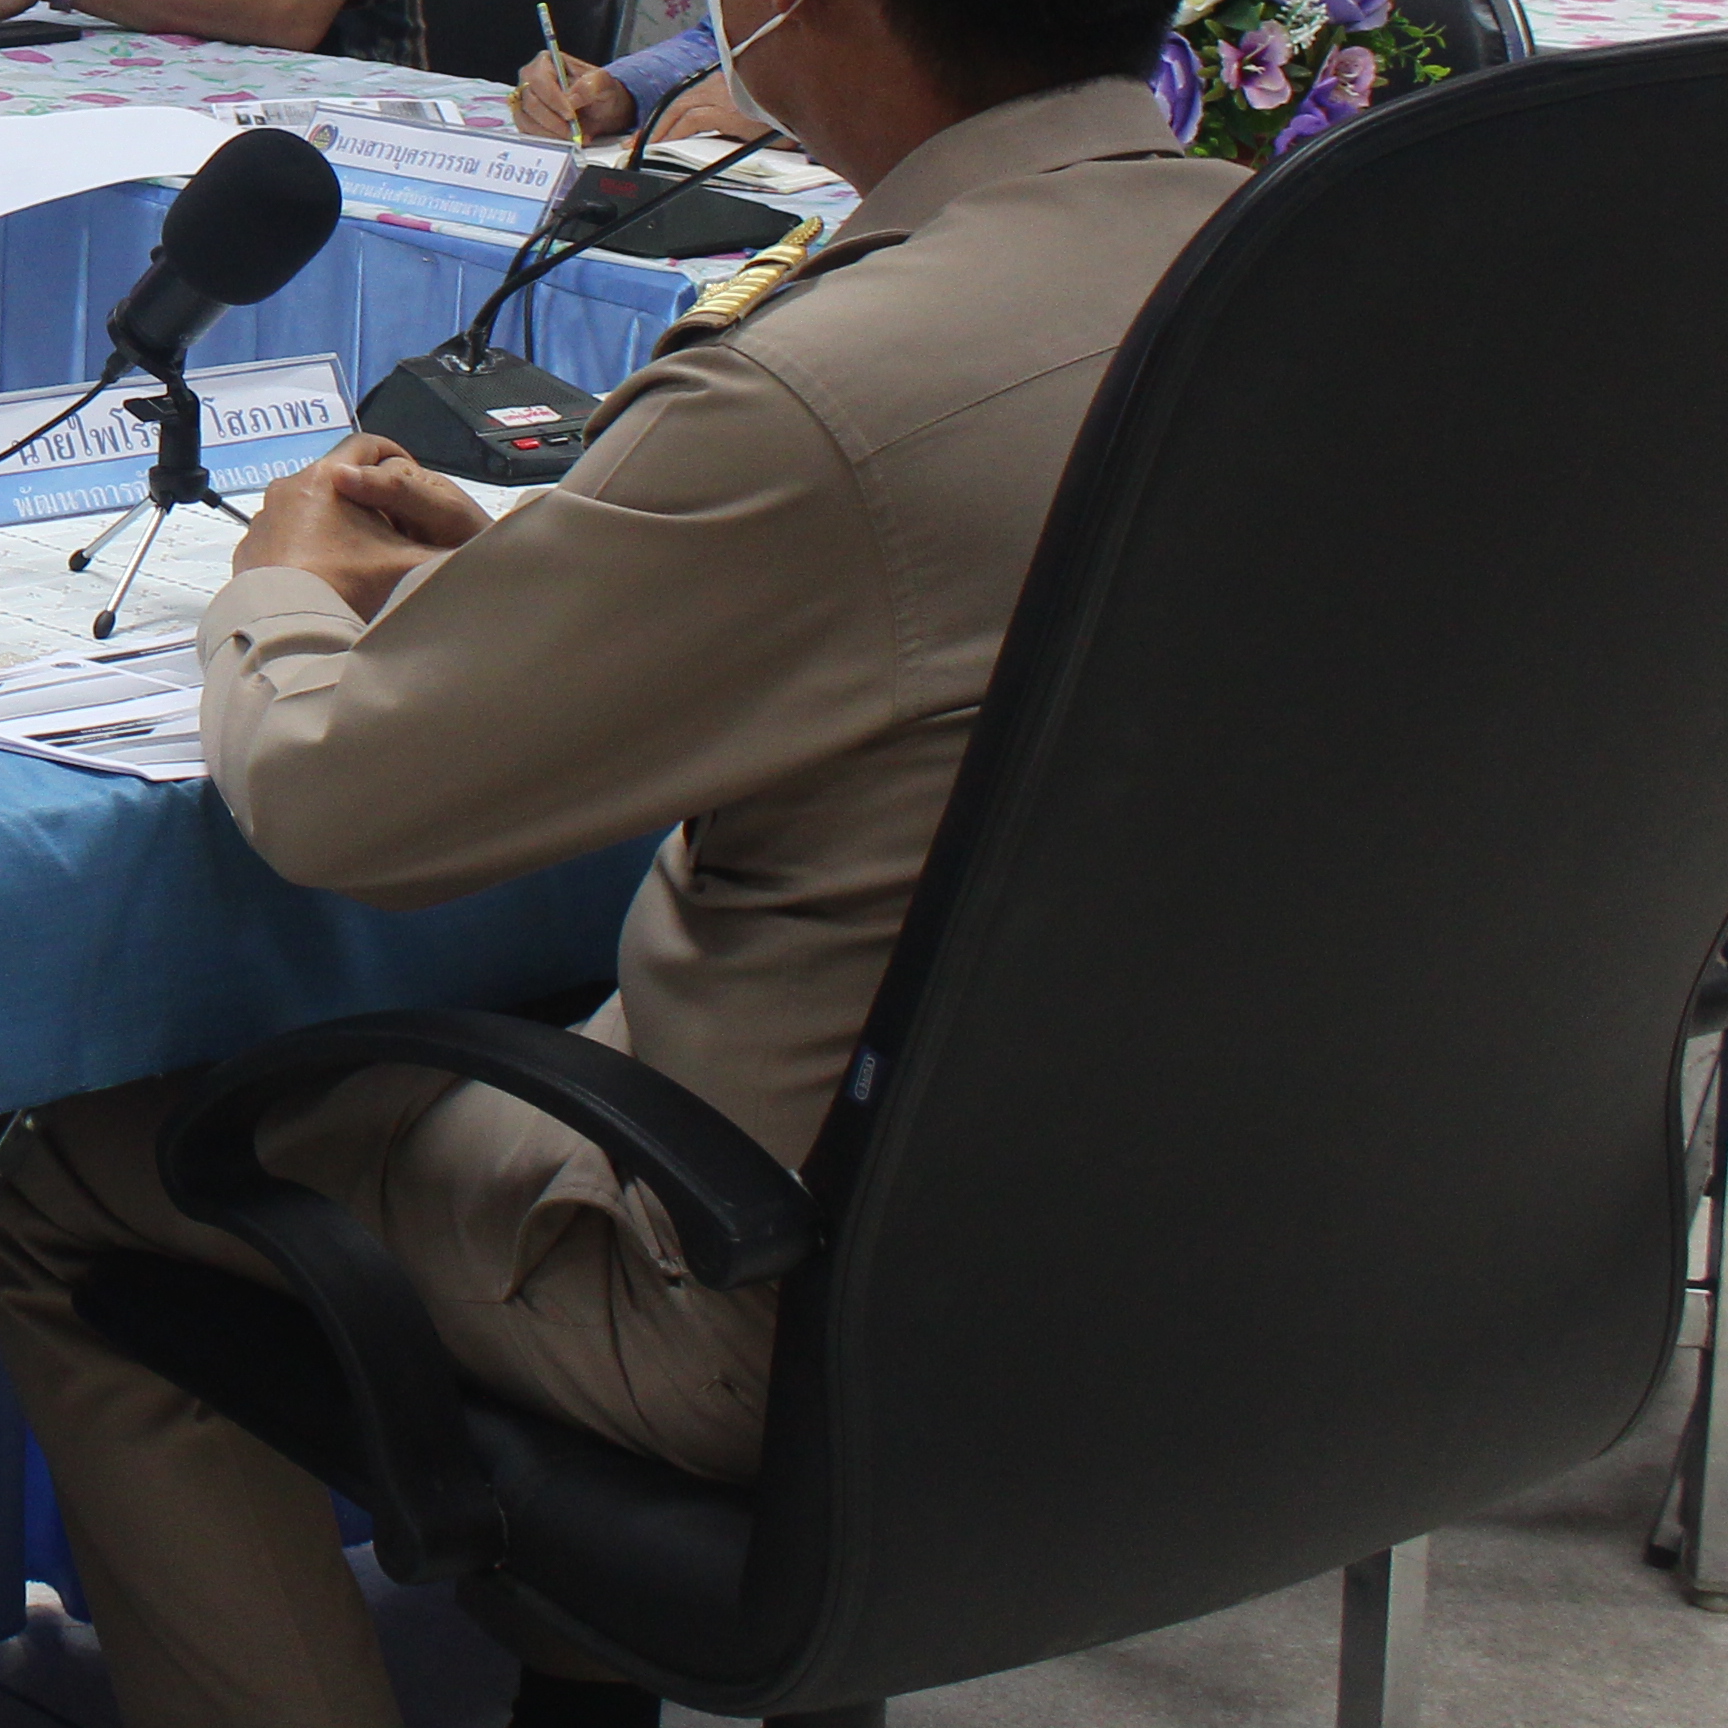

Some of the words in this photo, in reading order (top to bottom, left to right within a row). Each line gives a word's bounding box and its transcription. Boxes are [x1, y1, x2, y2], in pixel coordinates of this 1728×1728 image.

[334, 135, 480, 175] นางสาวบุศราวรรณ
[202, 395, 332, 439] โสภาพร
